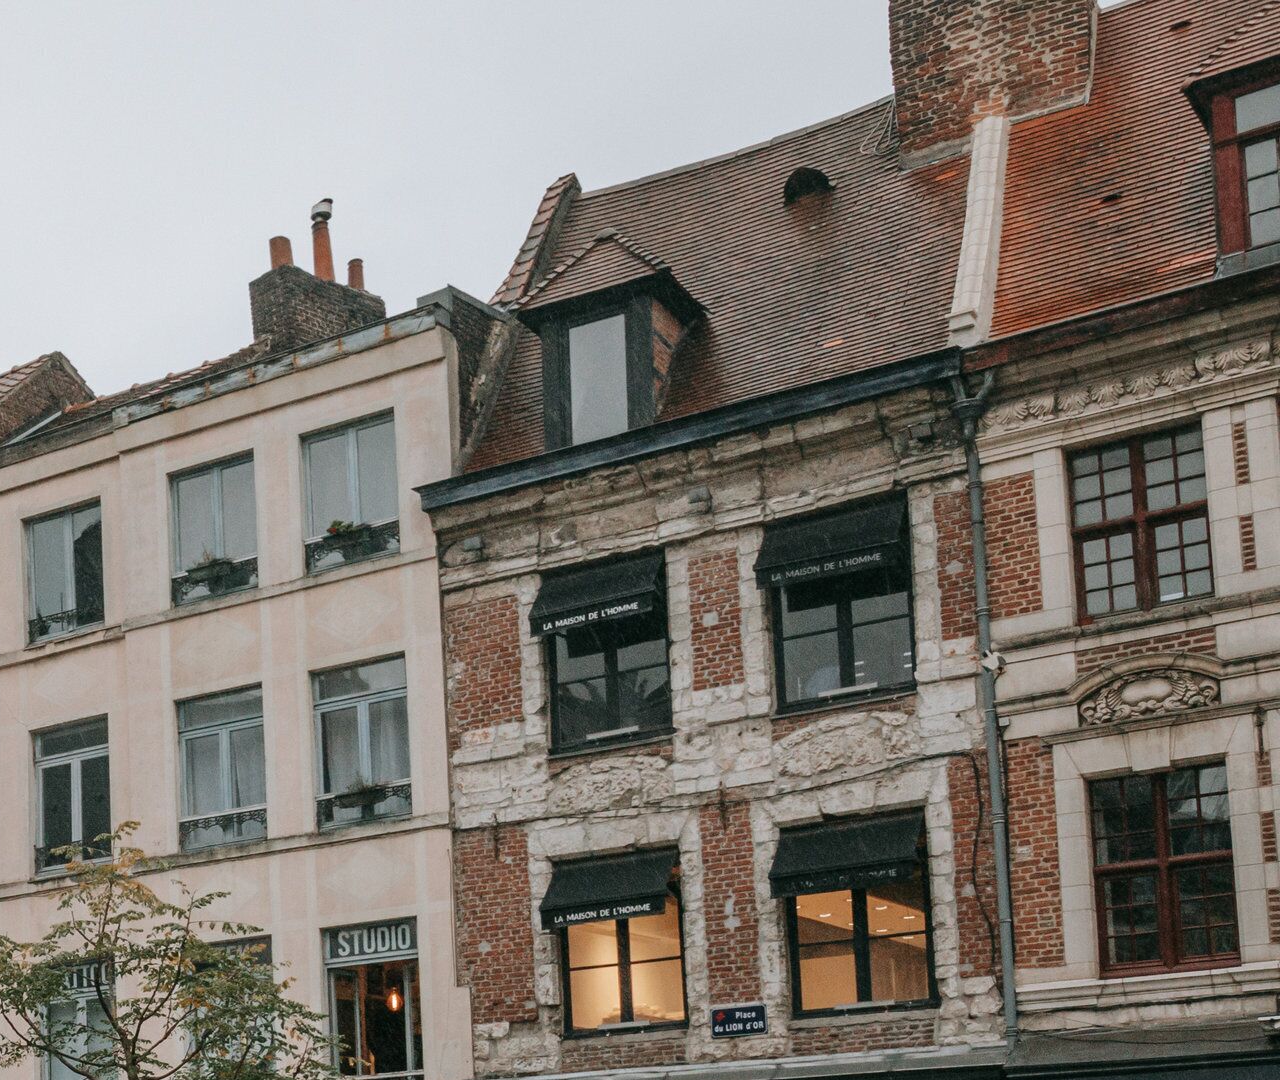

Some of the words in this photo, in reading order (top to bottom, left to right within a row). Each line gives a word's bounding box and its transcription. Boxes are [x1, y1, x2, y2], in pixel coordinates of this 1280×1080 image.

[771, 572, 782, 581] LA
[785, 565, 820, 578] MAISON
[824, 562, 835, 571] DE
[839, 552, 882, 568] L'HOMME
[543, 622, 553, 631] LA
[555, 614, 585, 627] MAISON
[588, 611, 598, 620] DE
[601, 602, 639, 617] L'HOMME
[554, 915, 563, 923] LA
[566, 911, 597, 922] MAISON
[600, 908, 610, 917] DE
[613, 903, 651, 915] L'HOMME
[337, 923, 411, 957] STUDIO
[714, 1024, 724, 1033] du
[725, 1022, 743, 1031] LION
[746, 1020, 764, 1030] d'OR
[735, 1011, 756, 1019] Place
